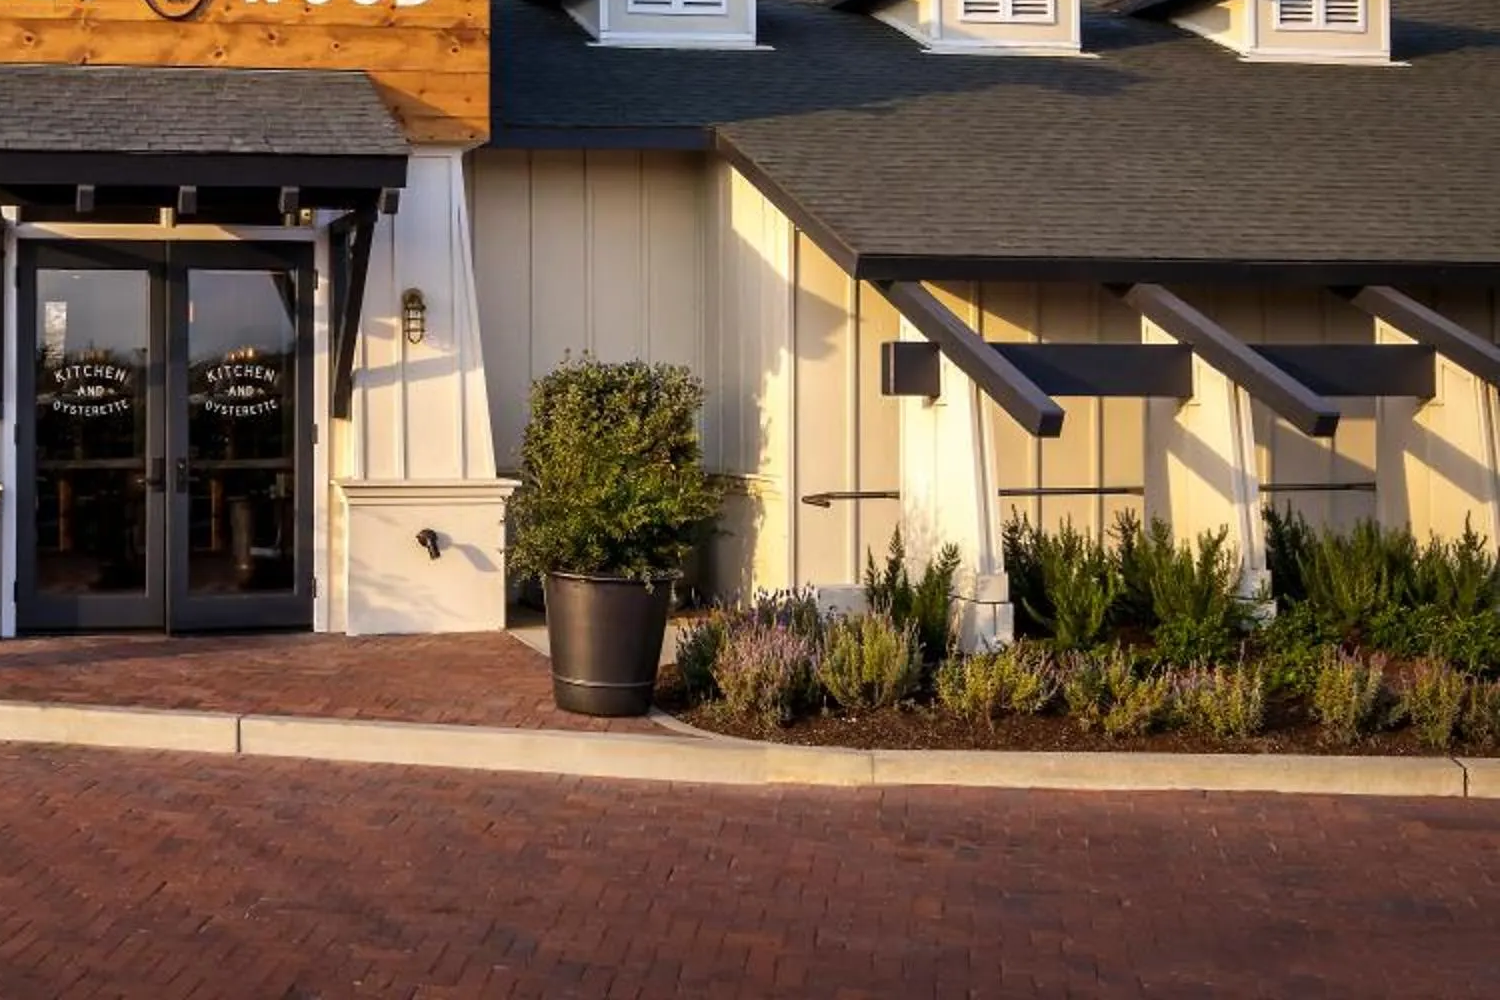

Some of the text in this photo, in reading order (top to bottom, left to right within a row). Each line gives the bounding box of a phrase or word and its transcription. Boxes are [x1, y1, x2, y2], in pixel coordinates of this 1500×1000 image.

[53, 364, 127, 383] KITCHEN
[206, 364, 276, 383] KITCHEN
[77, 385, 105, 397] AND
[227, 385, 255, 397] AND
